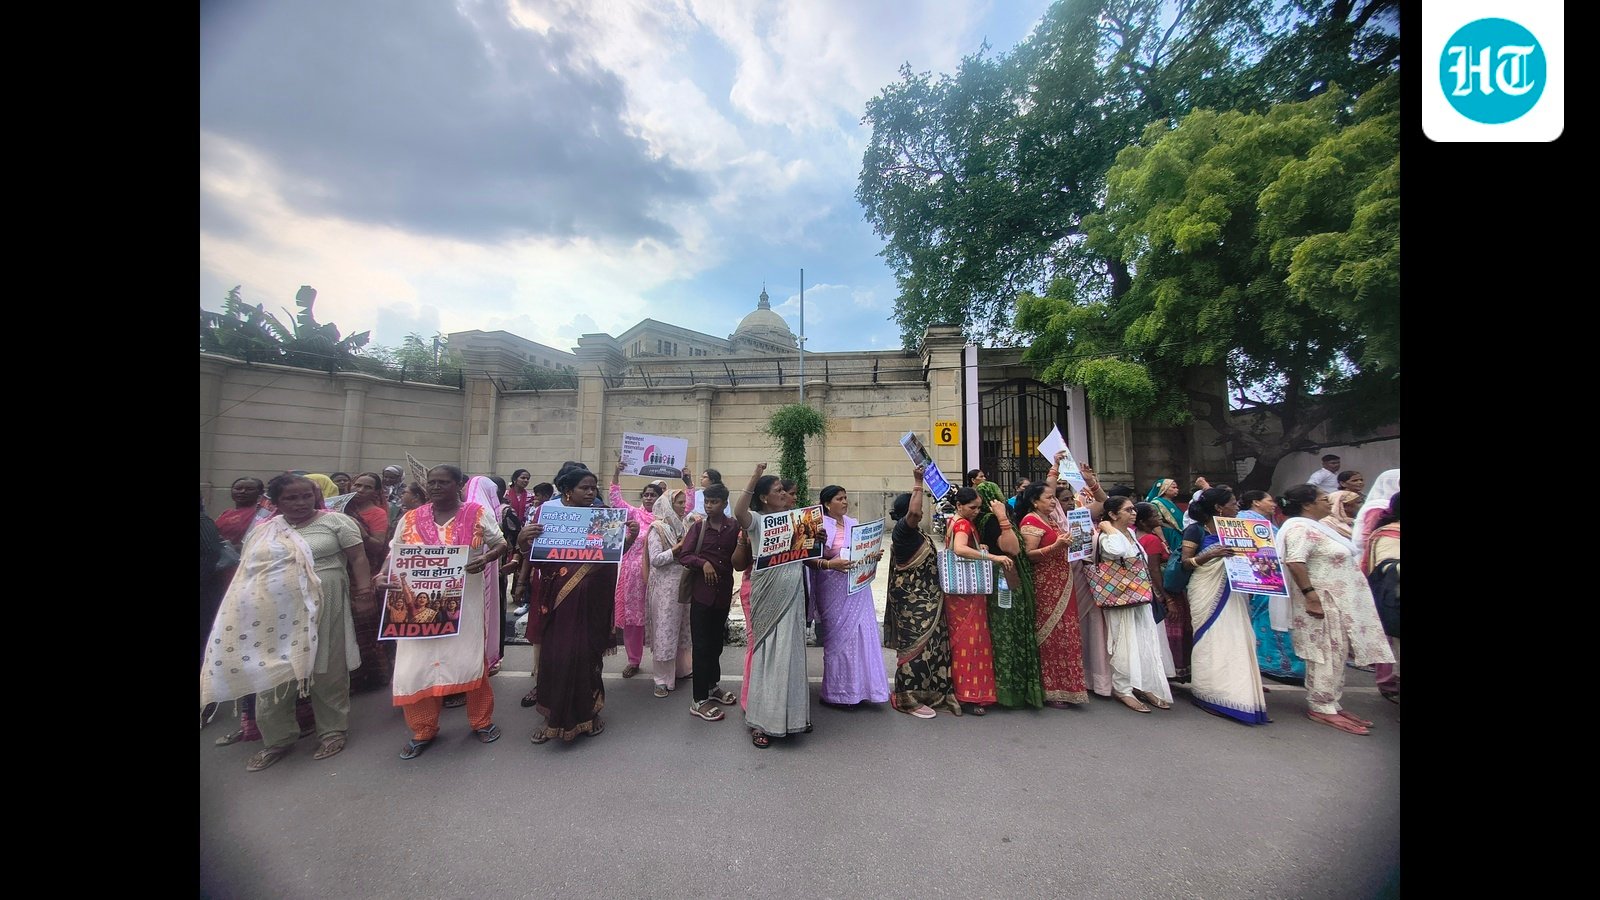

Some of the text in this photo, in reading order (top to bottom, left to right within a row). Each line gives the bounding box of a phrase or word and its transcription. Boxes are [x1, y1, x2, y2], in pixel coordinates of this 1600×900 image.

[941, 428, 952, 442] 6
[763, 514, 788, 528] शिक्षा
[1227, 520, 1245, 528] MORE
[560, 524, 567, 532] के
[537, 537, 547, 545] यह
[548, 538, 572, 546] सरकार
[763, 536, 780, 546] देश
[1224, 538, 1254, 547] ACT NOW
[400, 546, 422, 555] हमारे
[424, 546, 446, 555] बच्चों
[547, 548, 604, 560] AIDWA
[396, 555, 449, 569] भविष्य
[768, 549, 808, 566] AIDWA
[412, 569, 430, 577] क्या
[412, 580, 442, 589] जवाब
[383, 622, 455, 636] AIDWA
